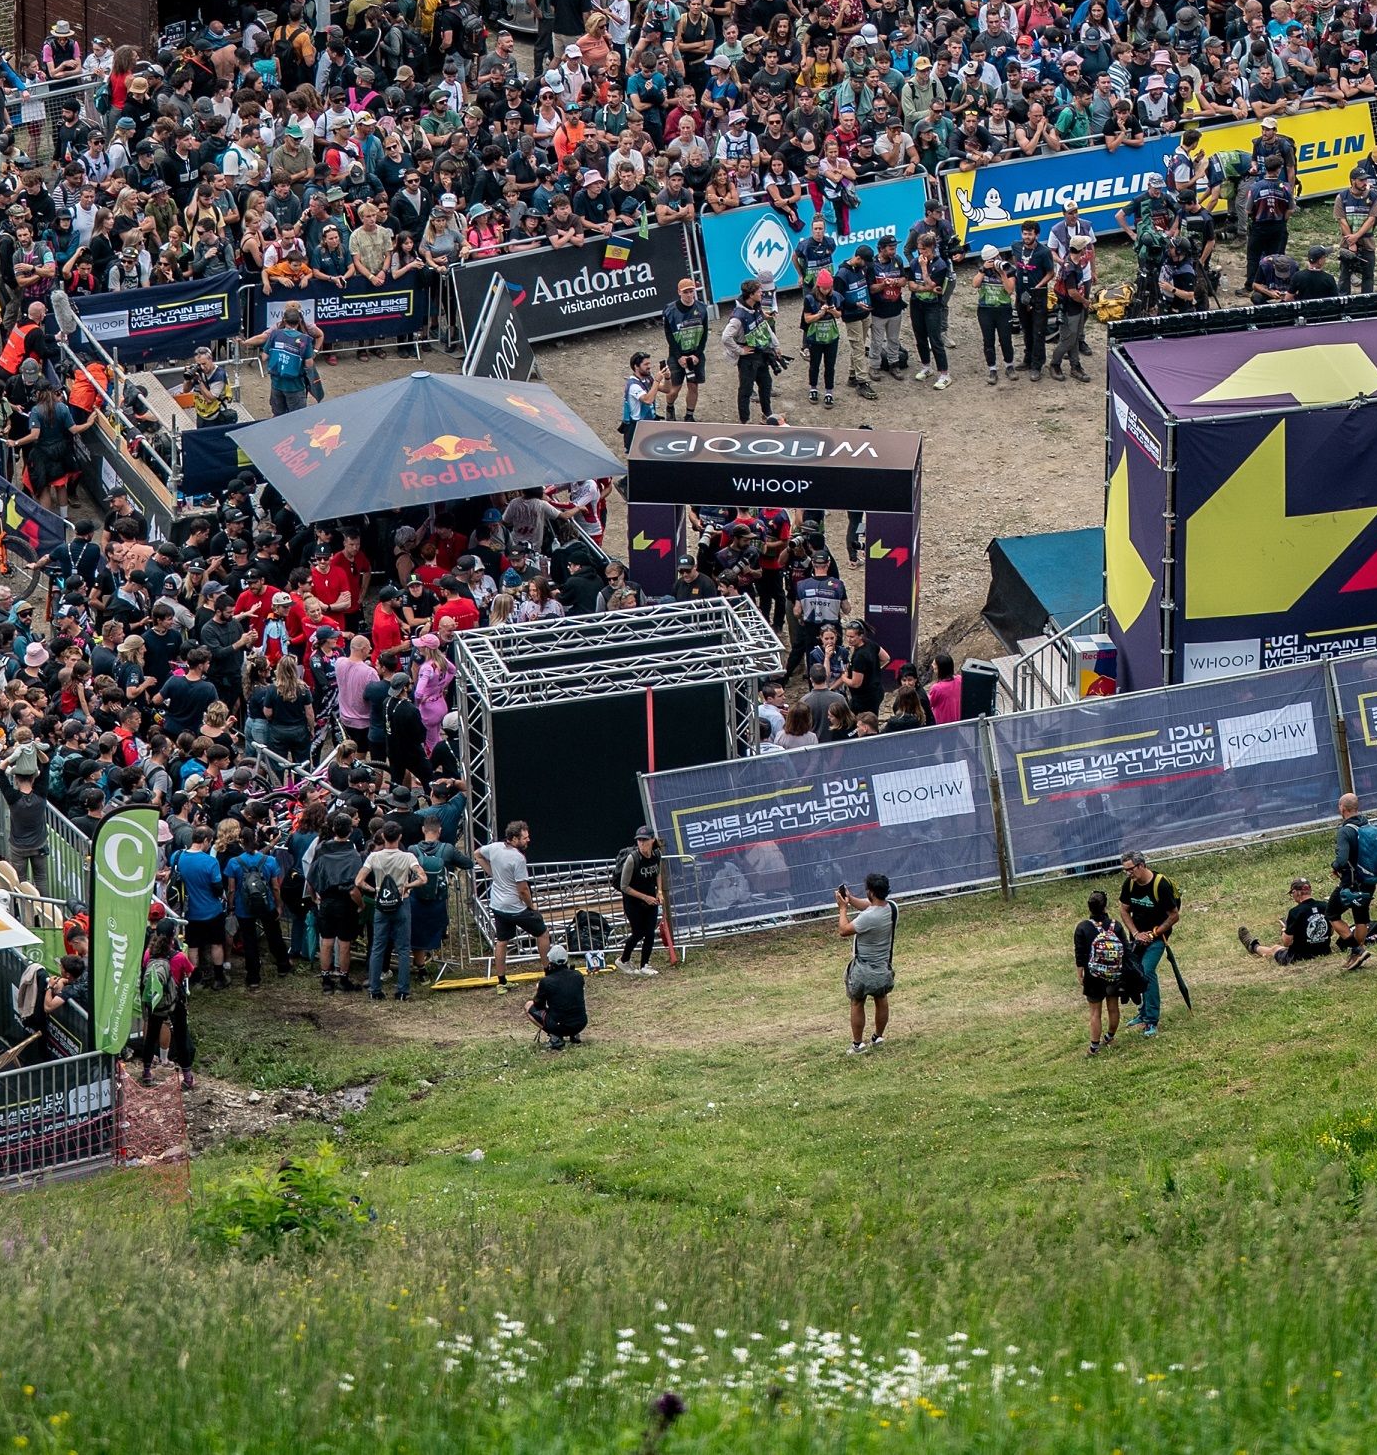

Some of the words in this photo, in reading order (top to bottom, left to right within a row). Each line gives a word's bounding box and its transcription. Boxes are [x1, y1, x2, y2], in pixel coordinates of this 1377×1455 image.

[530, 260, 656, 306] Andorra
[317, 300, 379, 313] MOUNTAIN
[380, 296, 408, 307] BIKE
[321, 297, 340, 305] UCI
[559, 286, 658, 315] visitandorra.com
[130, 307, 193, 322] MOUNTAIN
[195, 302, 223, 312] BIKE
[130, 315, 177, 328] WORLD
[178, 309, 223, 321] SERIES
[134, 306, 154, 315] UCI
[317, 307, 366, 319] WORLD
[367, 303, 408, 315] SERIES
[399, 464, 459, 491] Red
[459, 456, 516, 482] Bull
[732, 477, 812, 493] WHOOP
[1264, 638, 1360, 658] MOUNTAIN
[1271, 634, 1299, 646] UCI
[1189, 652, 1255, 670] WHOOP
